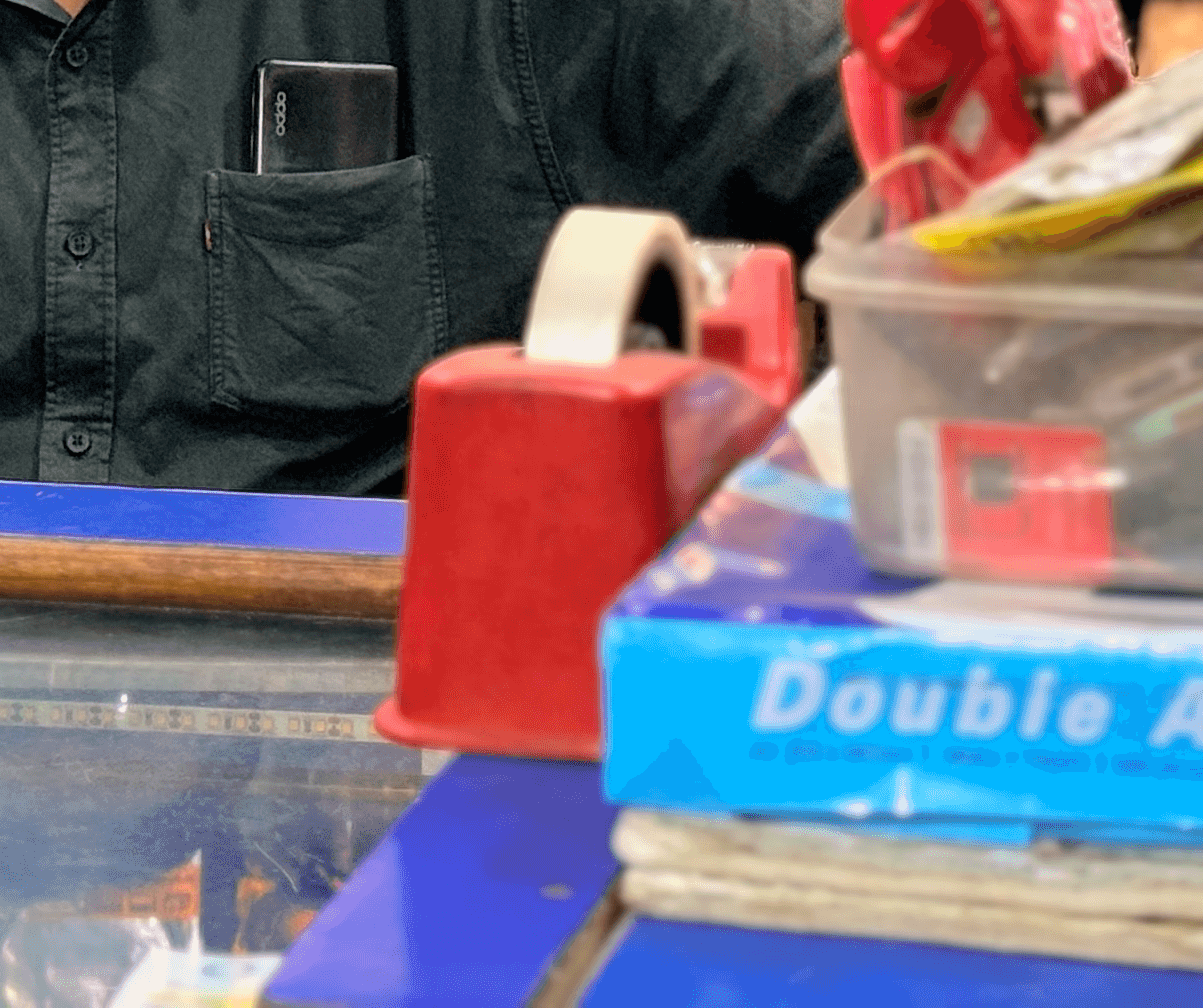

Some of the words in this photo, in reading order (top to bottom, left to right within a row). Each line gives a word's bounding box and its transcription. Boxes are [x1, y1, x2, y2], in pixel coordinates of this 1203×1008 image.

[274, 91, 286, 136] oppo
[751, 659, 1114, 745] Double
[1145, 677, 1203, 752] A
